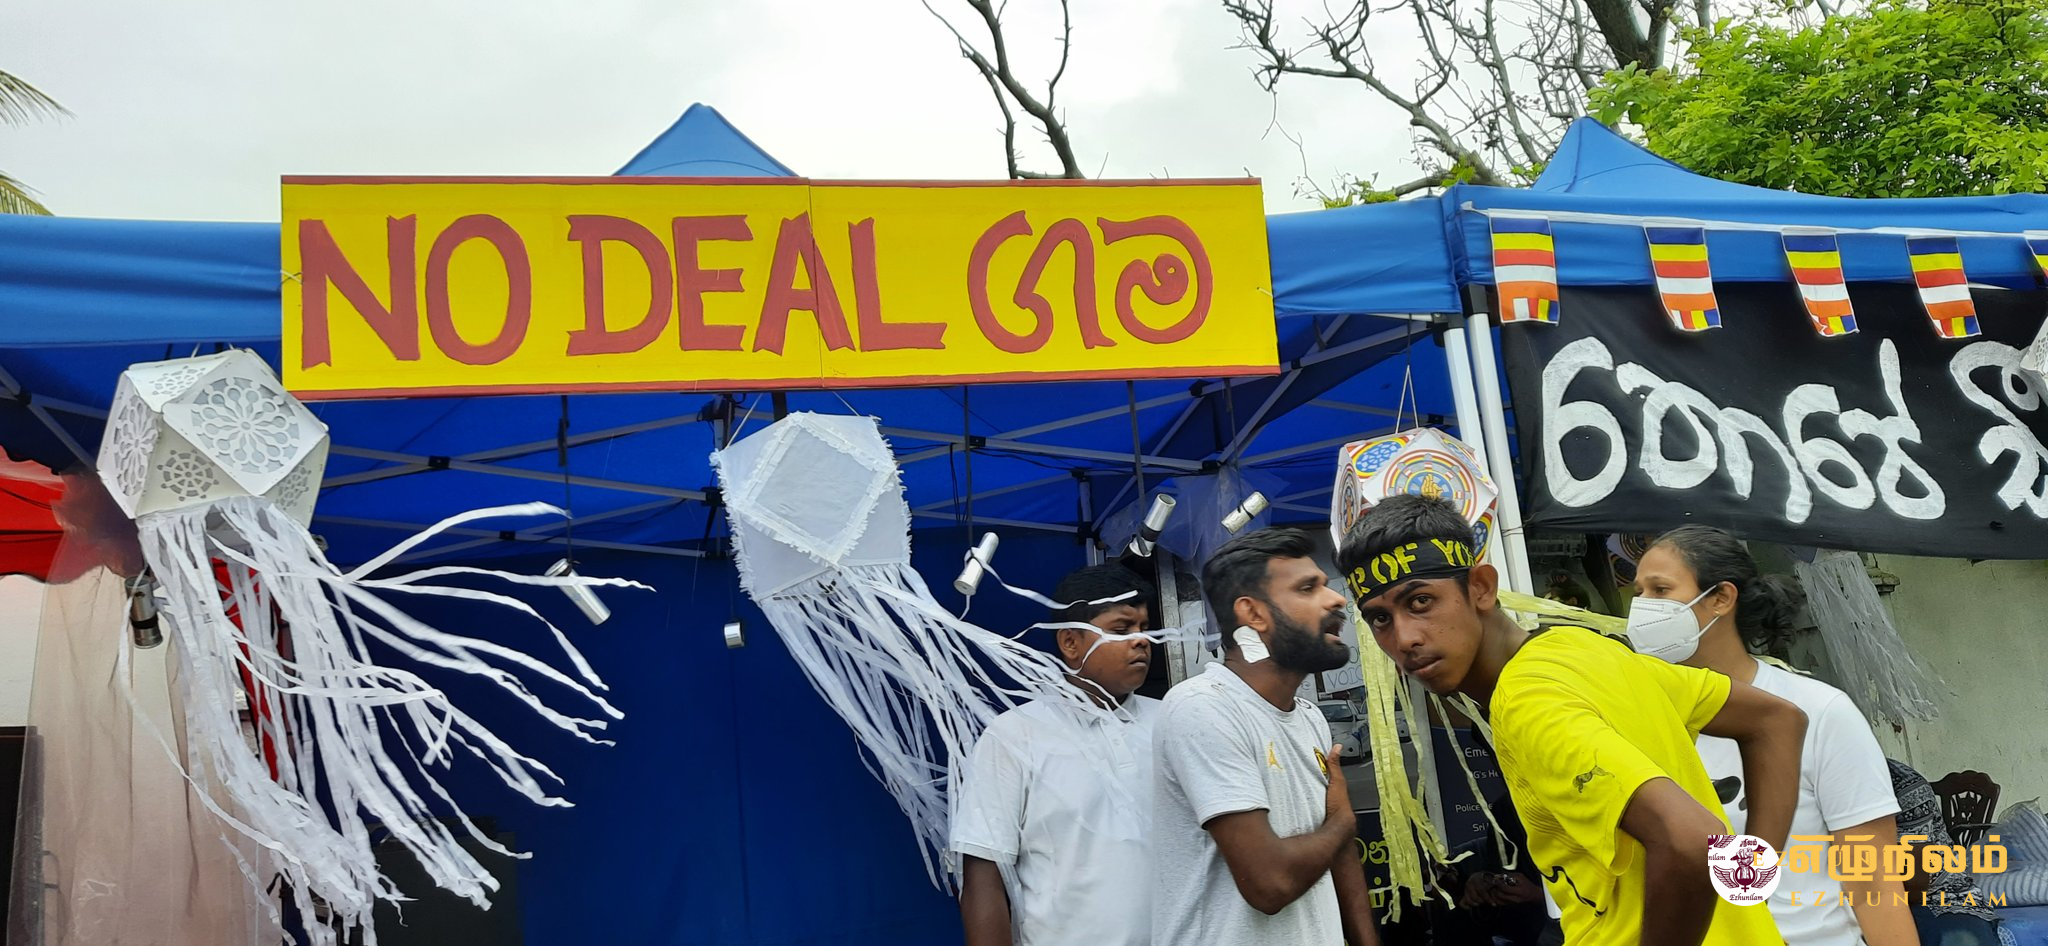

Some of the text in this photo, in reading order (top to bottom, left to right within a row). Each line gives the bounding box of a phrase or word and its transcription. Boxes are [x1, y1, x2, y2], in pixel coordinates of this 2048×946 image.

[299, 213, 532, 371] NO
[566, 211, 948, 357] DEAL
[1347, 567, 1371, 598] R
[1371, 543, 1418, 584] OF
[1455, 804, 1480, 813] Police
